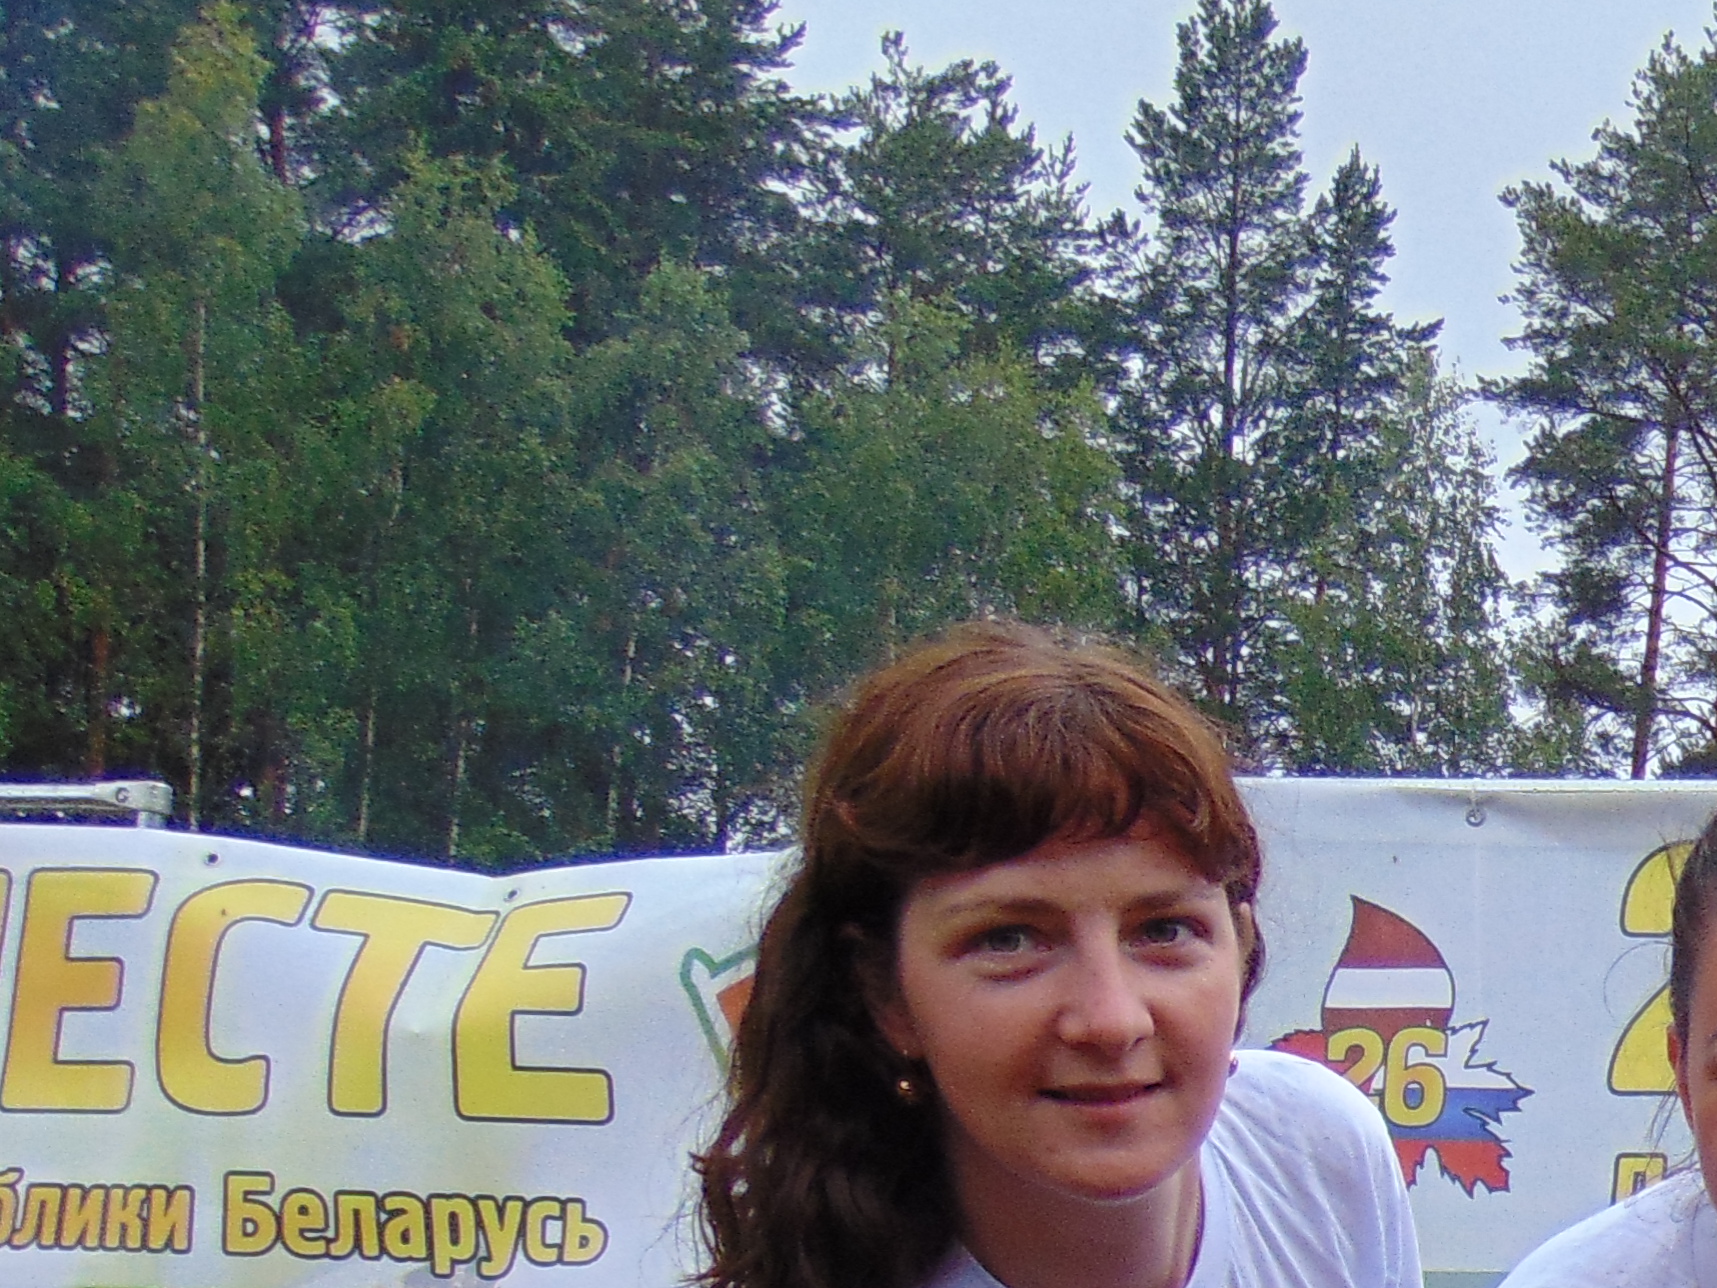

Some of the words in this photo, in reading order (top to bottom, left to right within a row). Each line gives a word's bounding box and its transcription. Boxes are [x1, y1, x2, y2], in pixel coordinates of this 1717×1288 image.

[0, 866, 633, 1126] ЕСТЕ
[1326, 1025, 1450, 1128] 26
[222, 1170, 609, 1278] Беларусь
